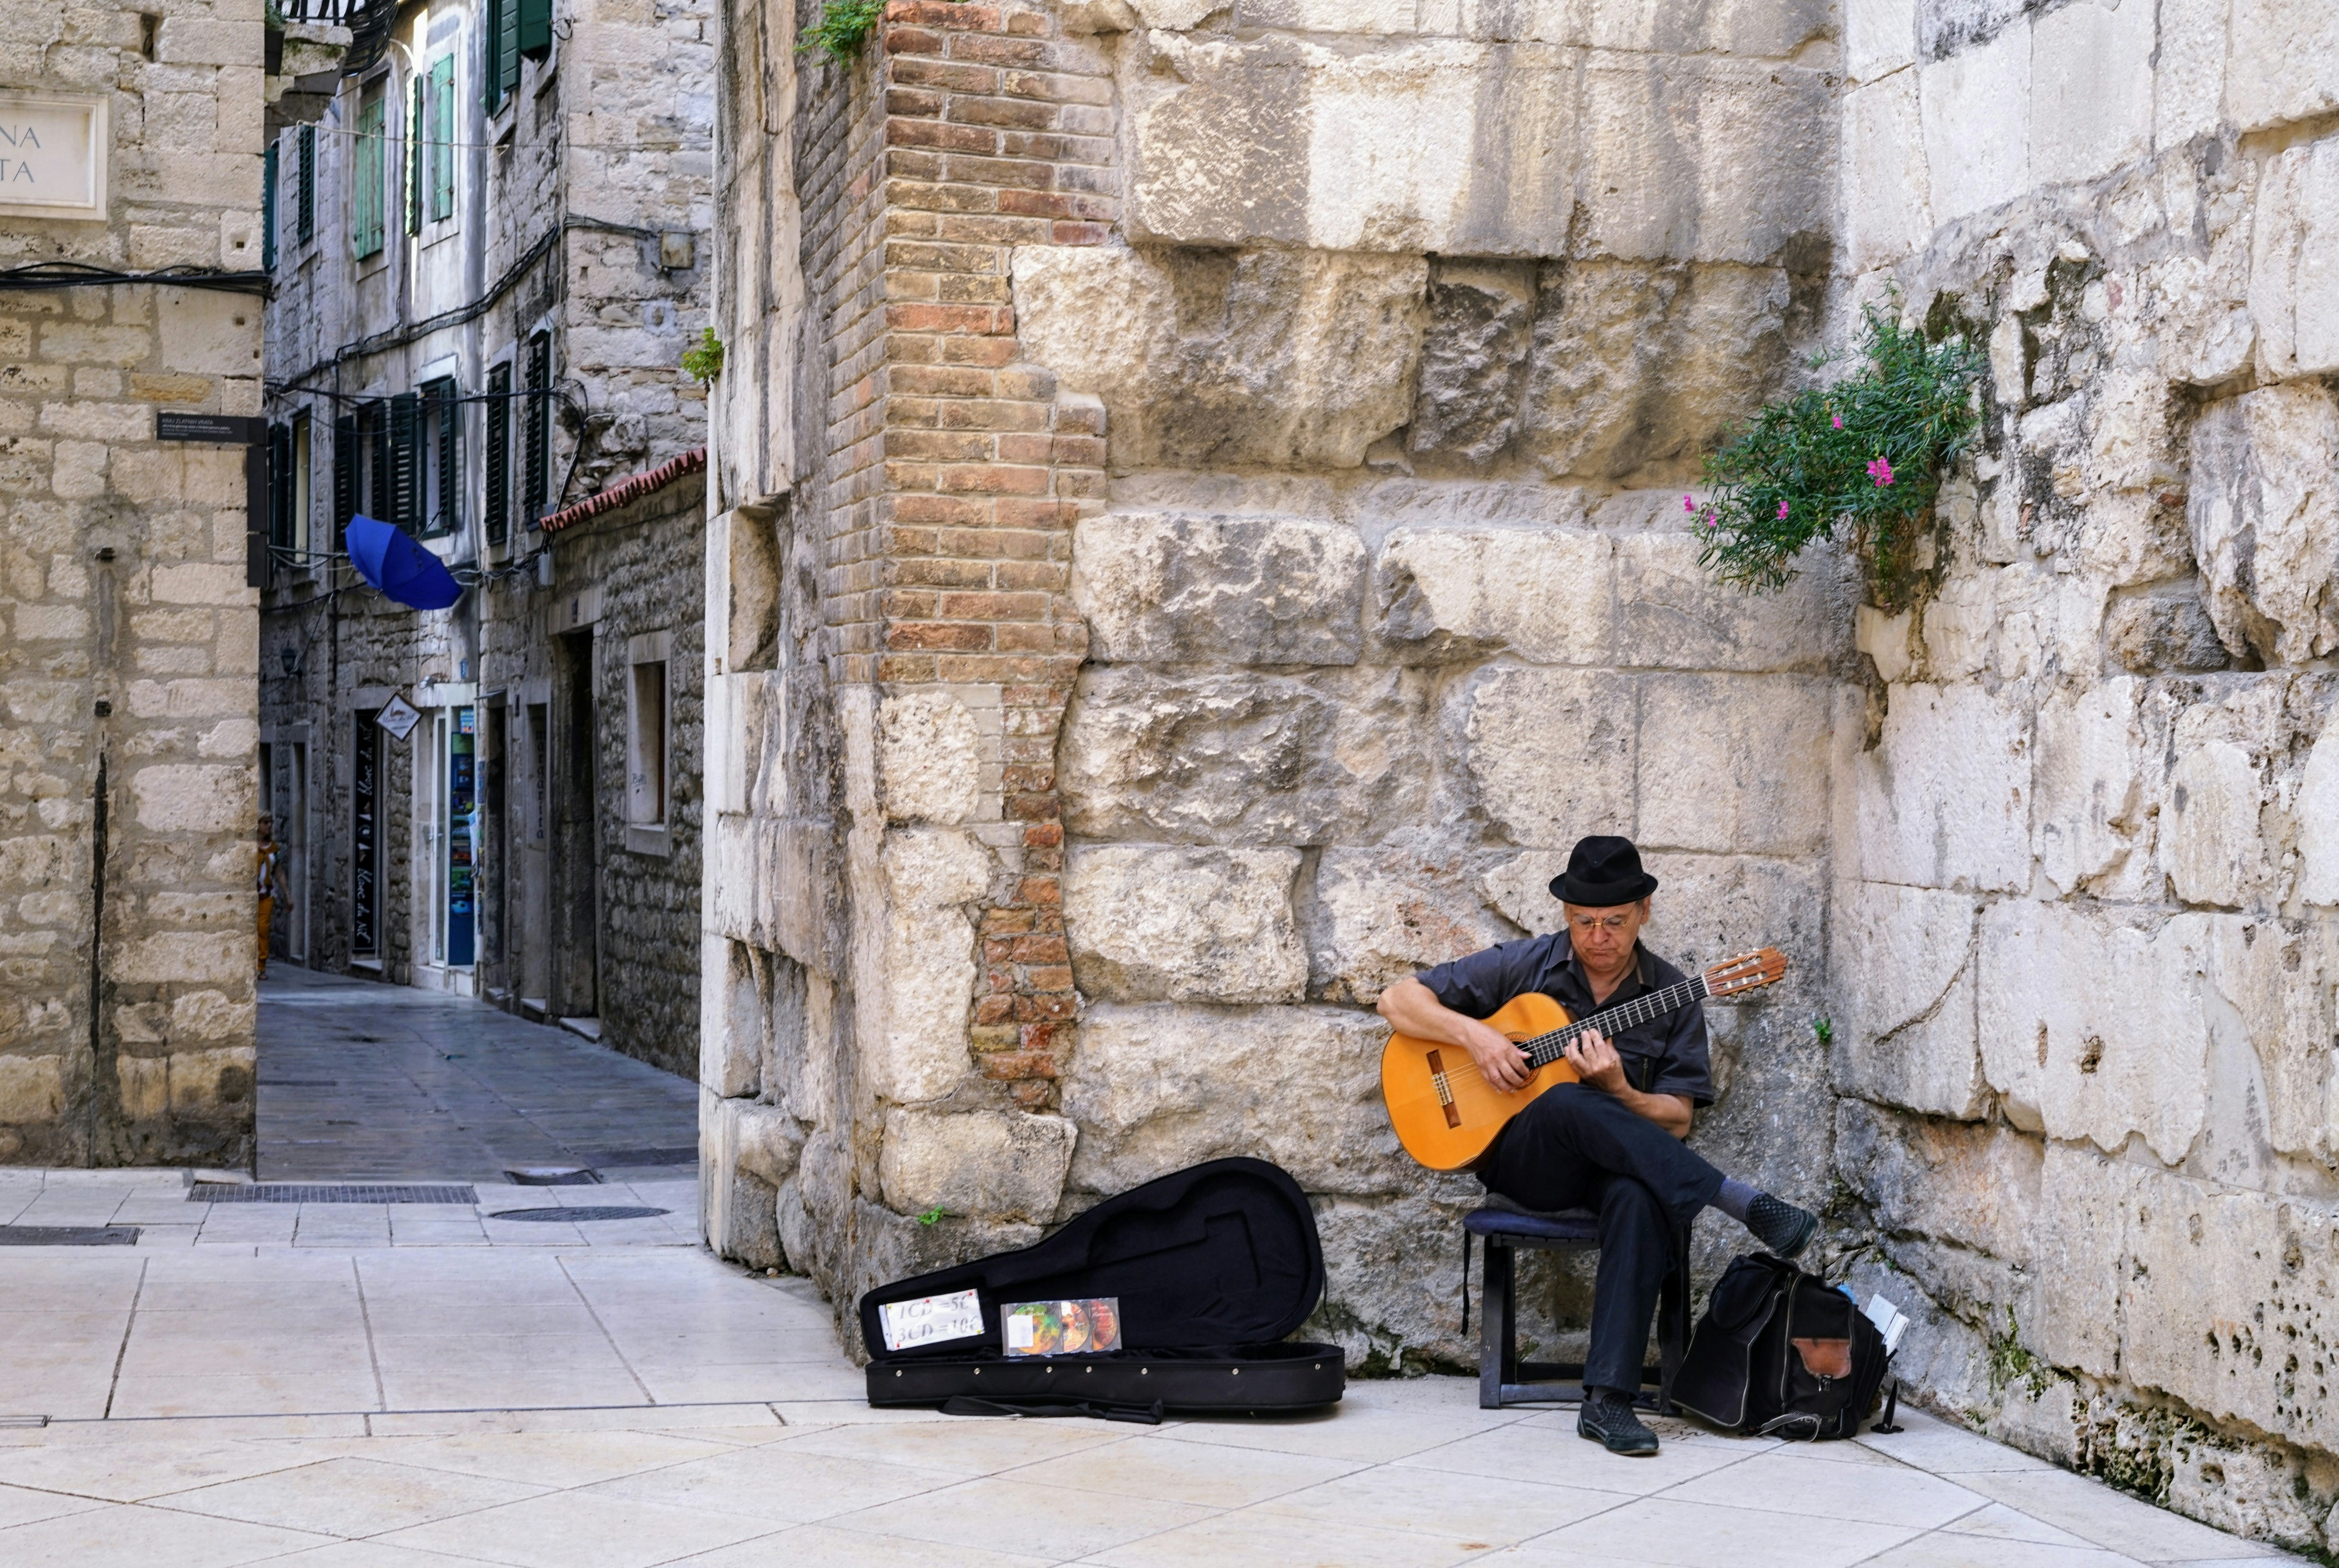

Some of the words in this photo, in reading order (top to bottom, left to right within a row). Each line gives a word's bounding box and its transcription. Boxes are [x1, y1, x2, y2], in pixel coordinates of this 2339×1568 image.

[0, 125, 41, 148] NA
[0, 158, 35, 183] TA
[898, 1324, 934, 1342] 3CD
